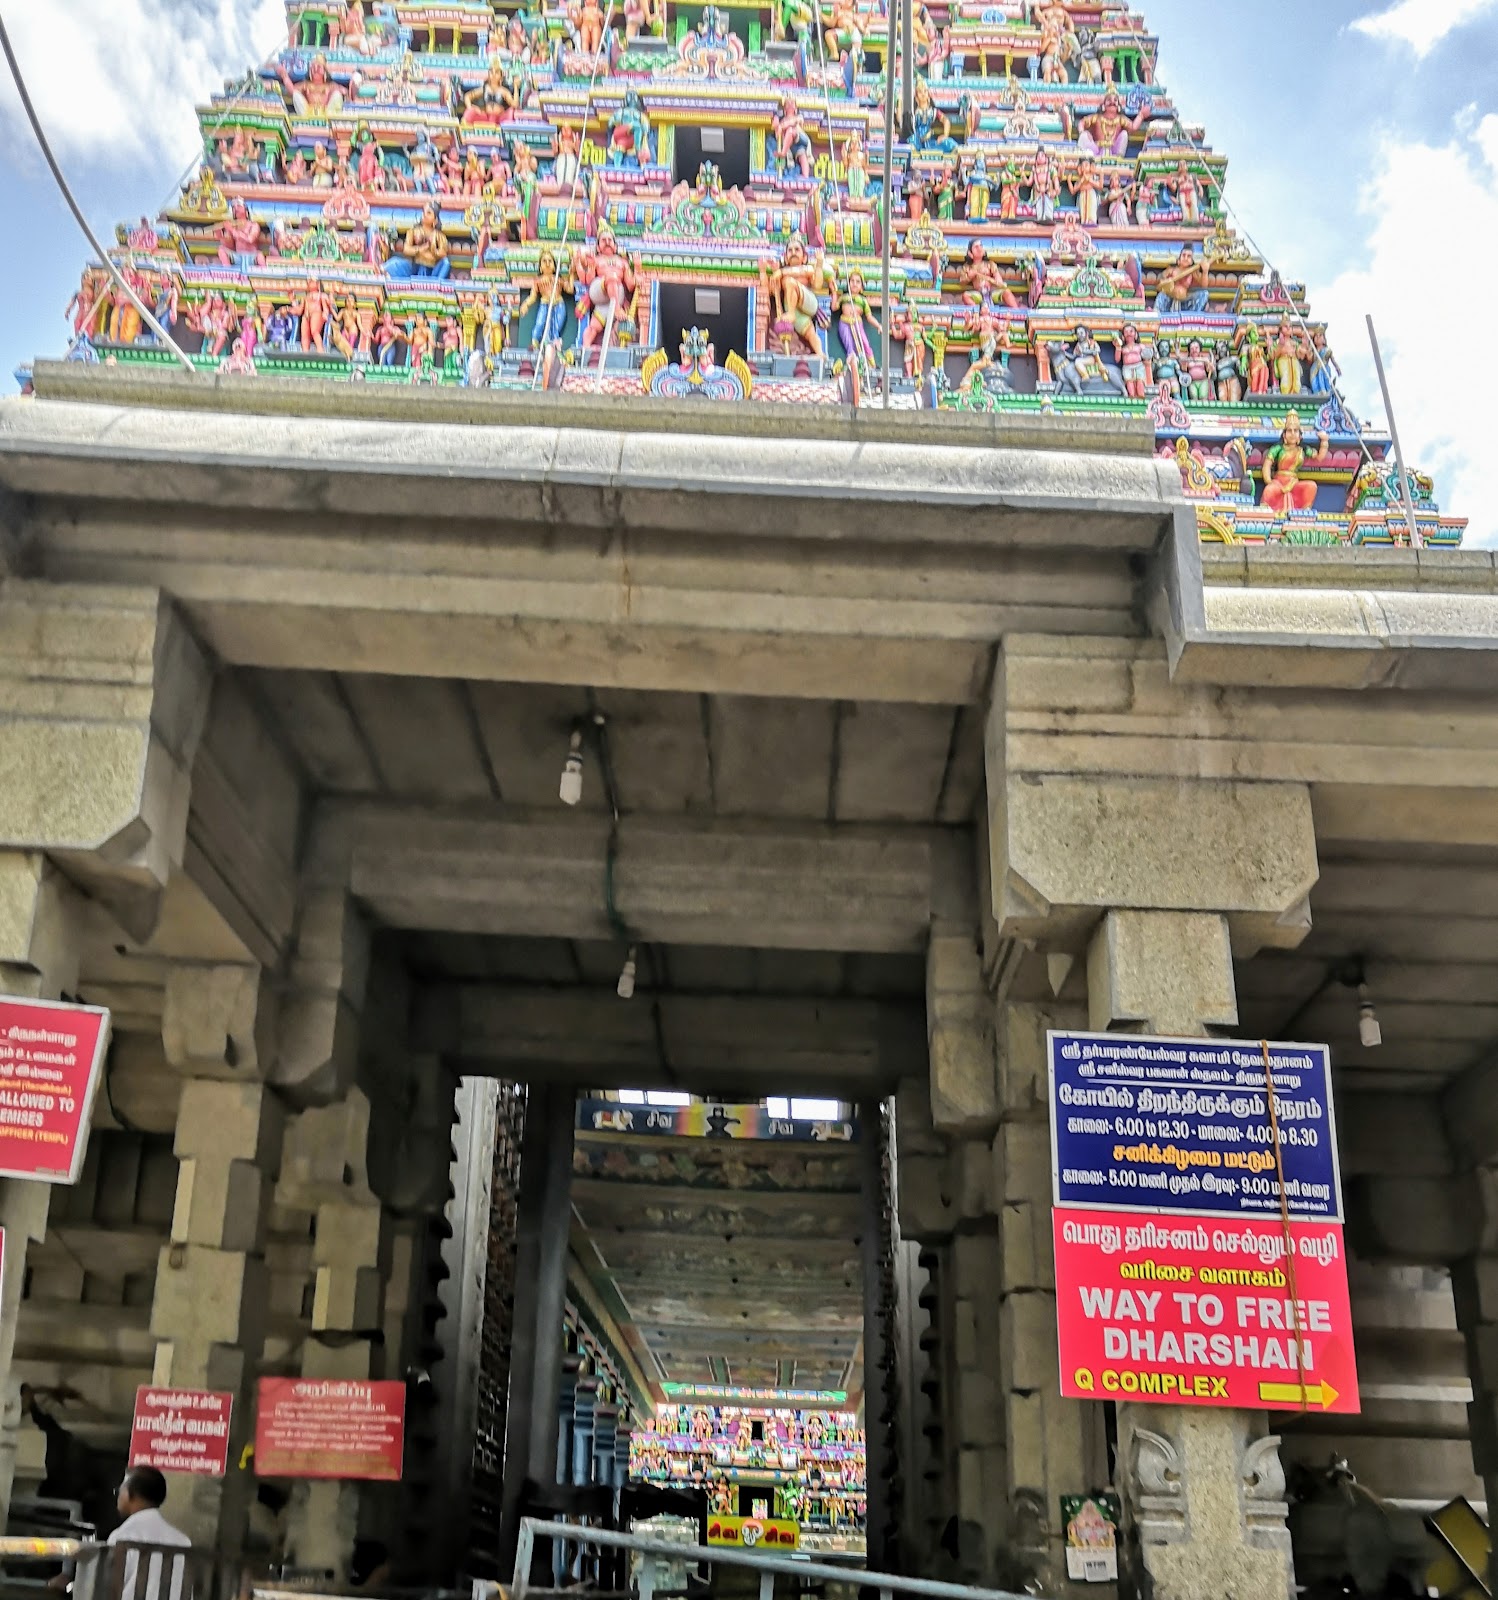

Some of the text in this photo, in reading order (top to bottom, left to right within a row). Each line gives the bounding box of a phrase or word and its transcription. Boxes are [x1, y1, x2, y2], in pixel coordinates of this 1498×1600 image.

[1146, 1066, 1189, 1079] பகவான்
[59, 1096, 75, 1113] TO
[1059, 1083, 1134, 1108] கோயில்
[1137, 1088, 1265, 1119] திறந்திருக்கும்
[1115, 1117, 1144, 1136] 6.00
[1145, 1119, 1157, 1137] to
[1158, 1120, 1190, 1139] 12.30
[1246, 1125, 1274, 1144] 4.00
[1288, 1127, 1318, 1147] 8.30
[1113, 1143, 1276, 1173] சனிக்கிழமை மட்டும்
[1109, 1169, 1137, 1187] 5.00
[1138, 1171, 1168, 1190] மணி
[1169, 1173, 1200, 1195] முதல்
[1241, 1177, 1270, 1195] 9.00
[1301, 1182, 1330, 1201] வரை
[1063, 1220, 1338, 1267] பொது தரிசனம் செல்லும் வழி
[1120, 1260, 1286, 1287] வரிசை வளாகம்
[1078, 1285, 1334, 1333] WAY TO FREE
[1103, 1327, 1314, 1371] DHARSHAN
[1074, 1367, 1230, 1399] Q COMPLEX
[186, 1414, 227, 1437] பைகள்
